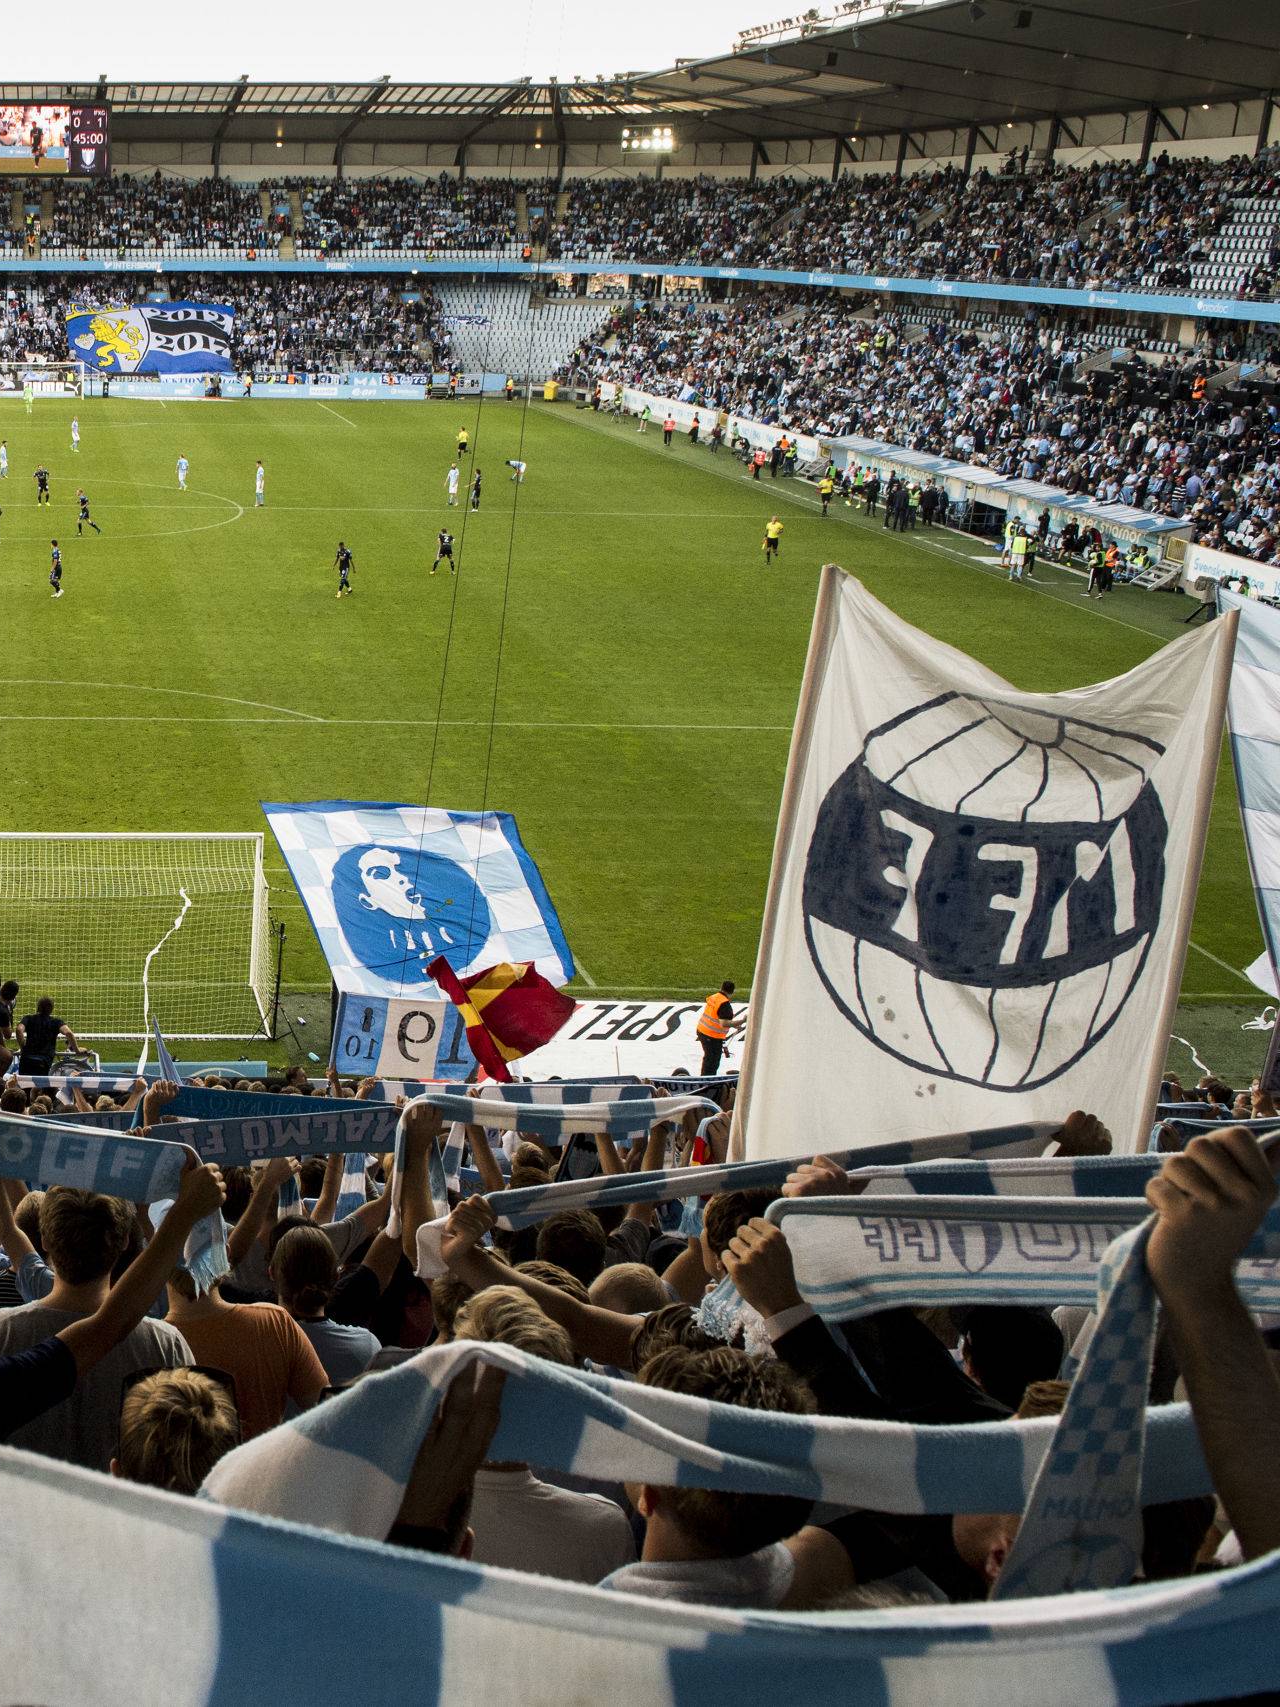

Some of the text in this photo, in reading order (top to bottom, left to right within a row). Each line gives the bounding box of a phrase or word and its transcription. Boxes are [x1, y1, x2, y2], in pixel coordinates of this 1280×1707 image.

[73, 118, 81, 128] 0
[73, 133, 104, 144] 45:00
[568, 1004, 702, 1042] SPEL
